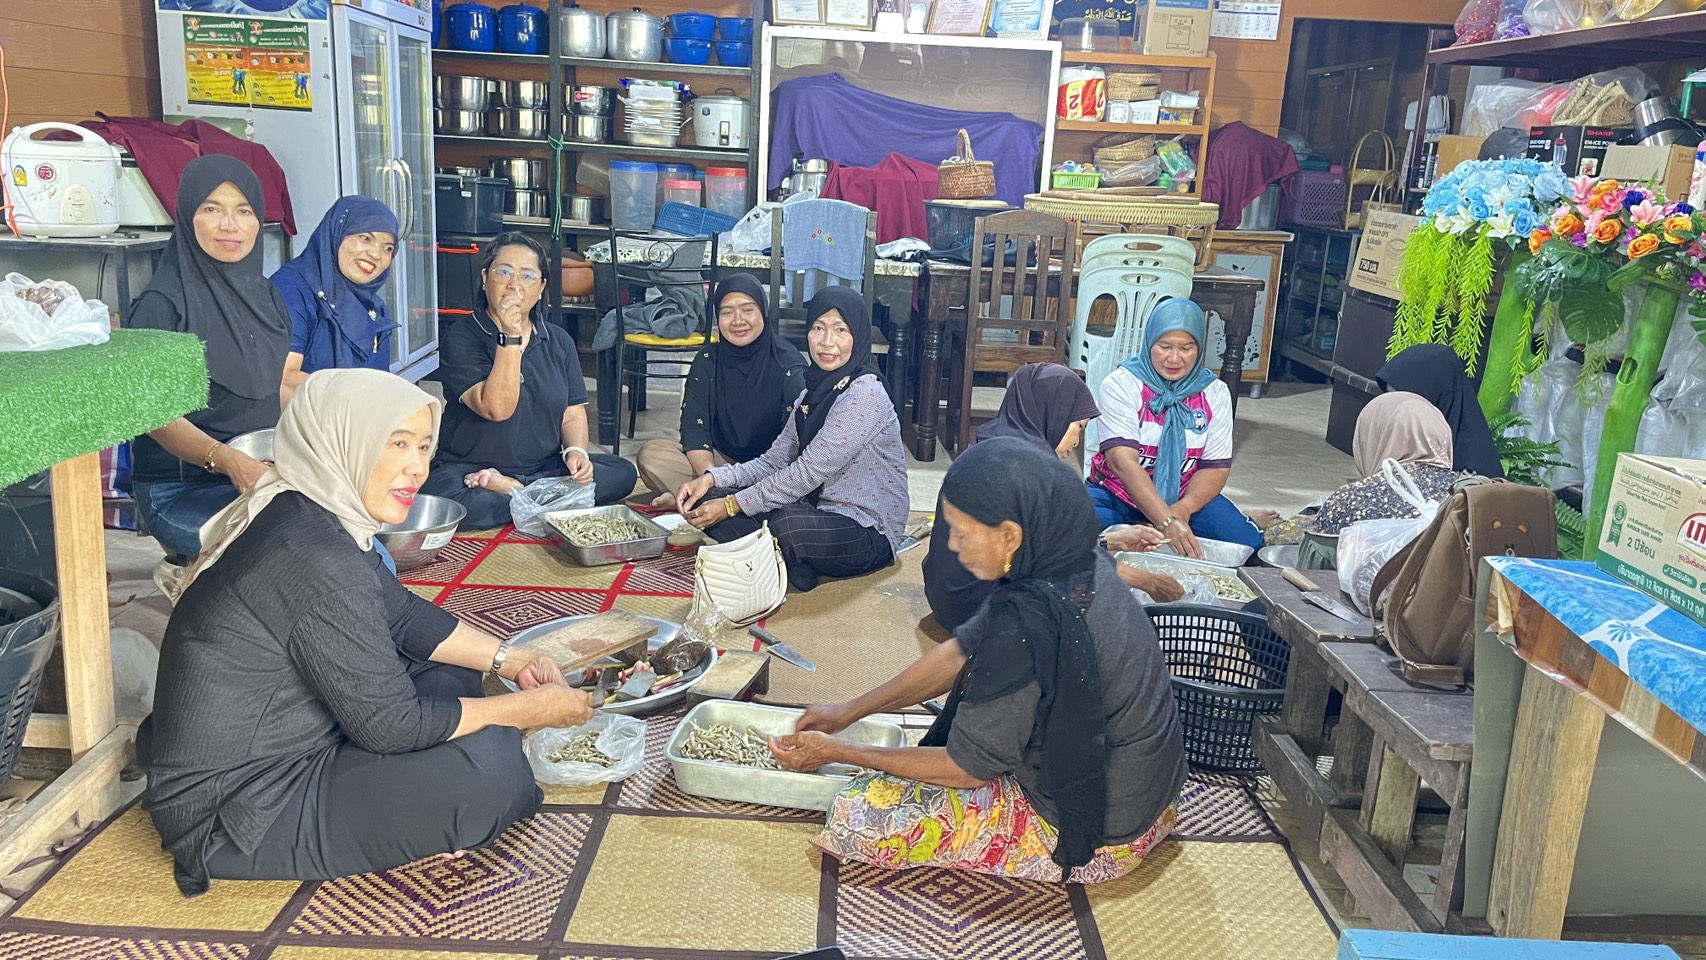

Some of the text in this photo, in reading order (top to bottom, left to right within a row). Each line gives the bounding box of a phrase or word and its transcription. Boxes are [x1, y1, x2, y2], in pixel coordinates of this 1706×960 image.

[1586, 129, 1614, 137] SHARP
[46, 170, 52, 178] 3
[1360, 259, 1370, 270] 750
[1627, 536, 1633, 548] 2
[1645, 579, 1652, 589] 12
[1652, 581, 1663, 595] ลิตร
[1669, 590, 1681, 605] ลิตร
[1687, 600, 1694, 612] 12
